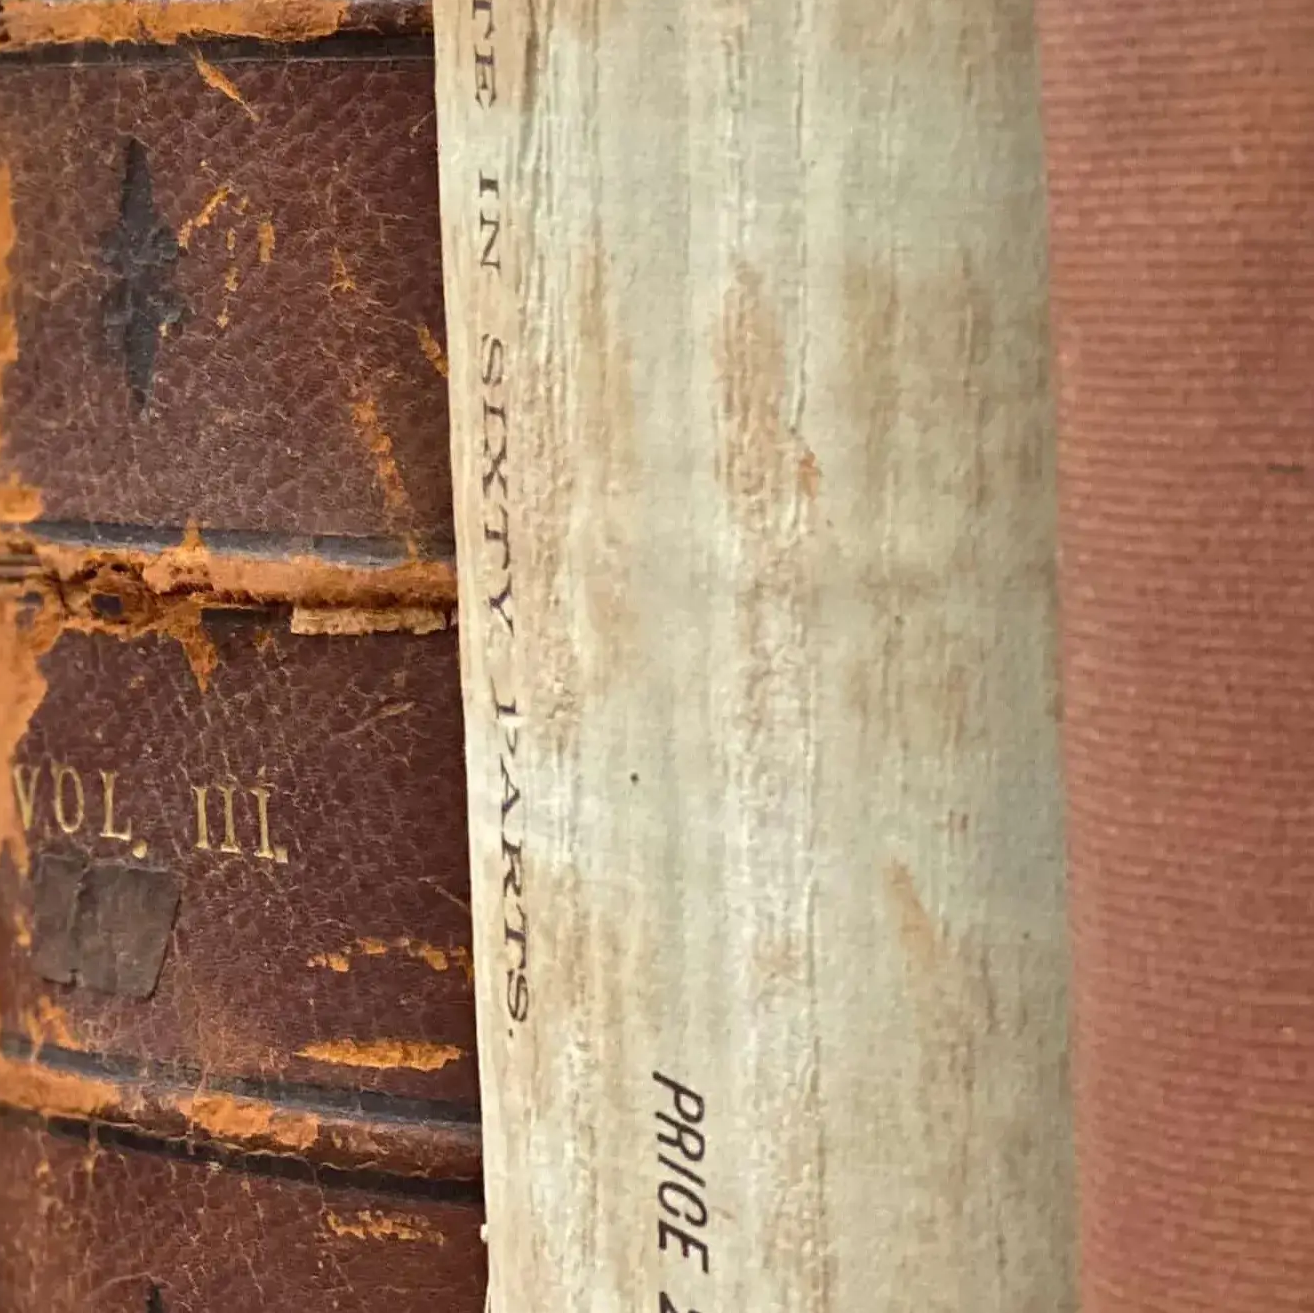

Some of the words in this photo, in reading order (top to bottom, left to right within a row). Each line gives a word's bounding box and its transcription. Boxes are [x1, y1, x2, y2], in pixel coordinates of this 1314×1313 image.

[479, 170, 501, 270] IN
[482, 332, 515, 638] SIXTY
[11, 762, 149, 860] VOL.
[189, 783, 289, 864] III.
[652, 1070, 710, 1275] PRICE
